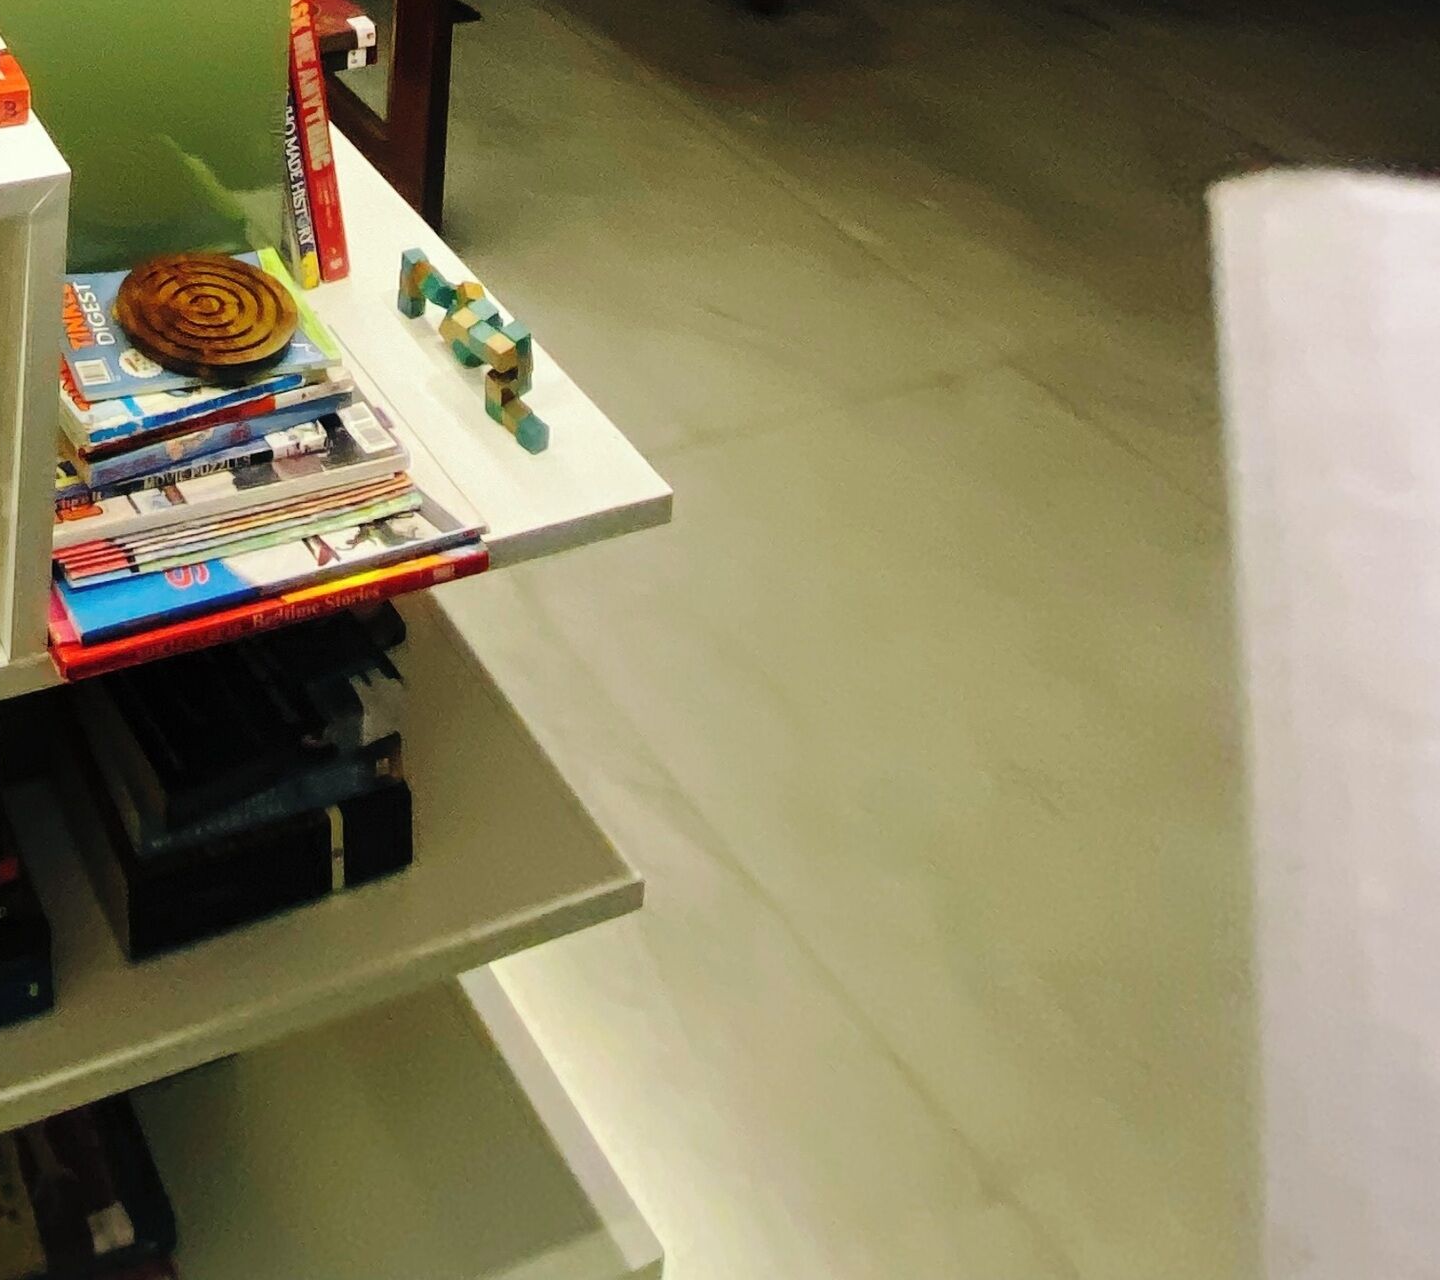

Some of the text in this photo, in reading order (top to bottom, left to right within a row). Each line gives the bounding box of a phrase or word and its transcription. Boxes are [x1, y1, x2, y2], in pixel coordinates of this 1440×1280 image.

[285, 140, 315, 246] MADE HISTORY
[74, 281, 116, 347] DIGEST
